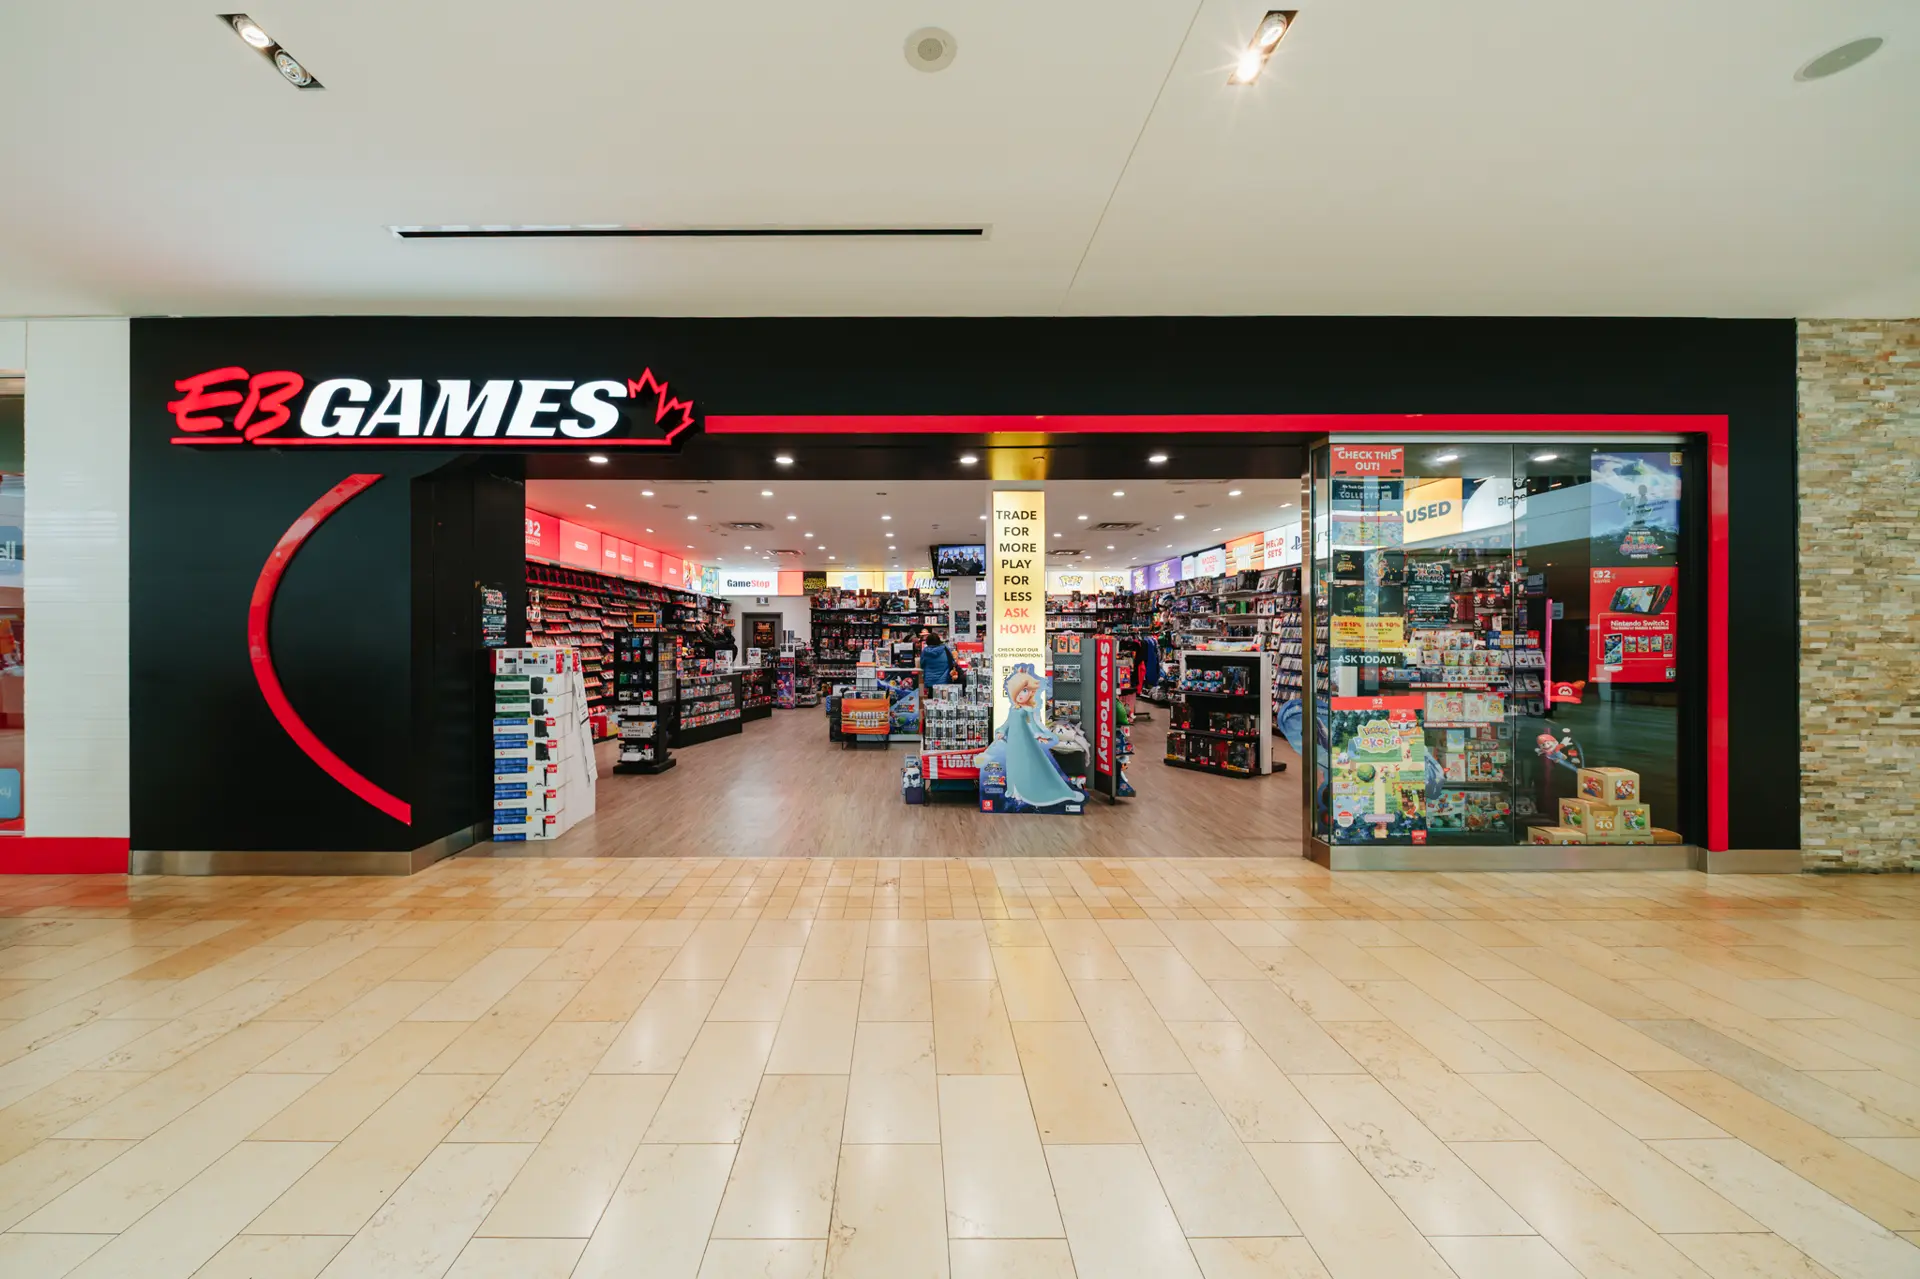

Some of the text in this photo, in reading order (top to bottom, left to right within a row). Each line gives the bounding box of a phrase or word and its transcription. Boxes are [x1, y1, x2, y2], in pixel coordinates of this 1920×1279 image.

[167, 366, 628, 440] EB GAMES
[1337, 451, 1397, 460] CHECK THIS
[1354, 462, 1381, 471] OUT!
[996, 510, 1037, 520] TRADE
[1406, 500, 1452, 524] USED
[1003, 526, 1029, 536] FOR
[999, 543, 1037, 553] MORE
[1267, 548, 1283, 559] SETS
[1001, 559, 1032, 569] PLAY
[727, 579, 770, 588] GameStop
[1003, 575, 1029, 585] FOR
[1004, 592, 1032, 601] LESS
[1004, 608, 1029, 618] ASK
[1000, 624, 1036, 634] HOW!
[1337, 655, 1396, 664] ASK TODAY!
[1097, 642, 1111, 772] Save Today!
[849, 711, 886, 719] FAMILY
[856, 720, 878, 728] FUN
